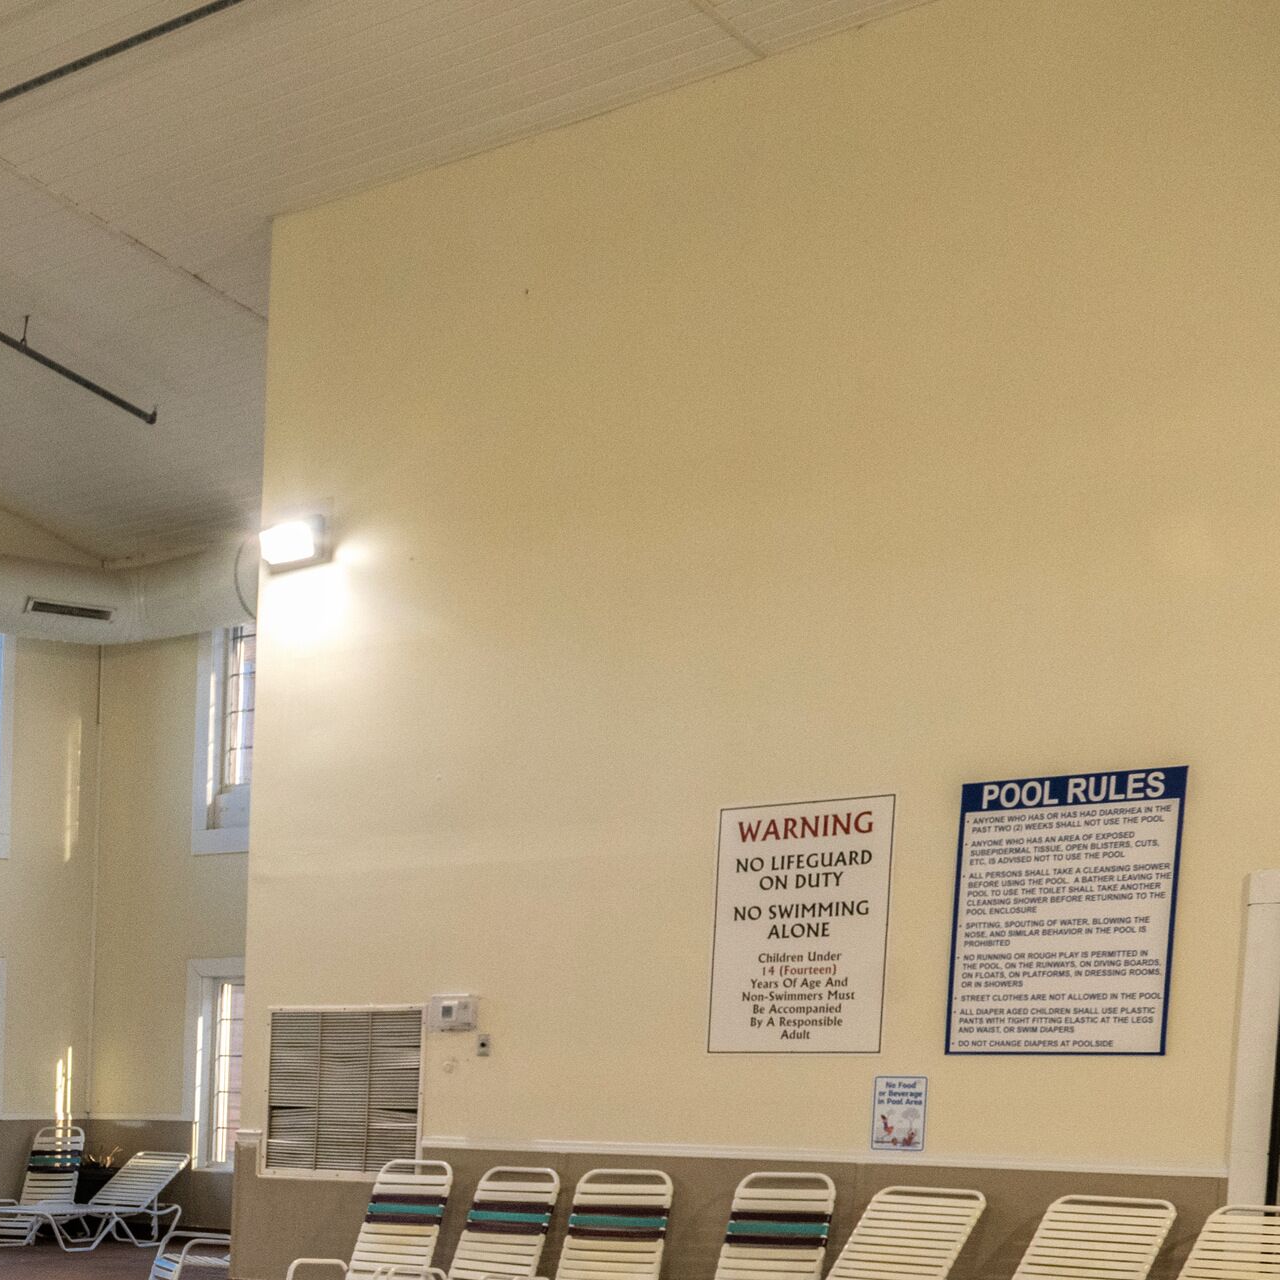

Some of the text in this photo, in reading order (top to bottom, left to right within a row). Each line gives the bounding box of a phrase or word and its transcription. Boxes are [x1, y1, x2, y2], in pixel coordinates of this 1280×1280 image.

[981, 771, 1166, 809] POOL RULES
[973, 816, 1005, 825] ANYONE
[1007, 814, 1027, 823] WHO
[1028, 813, 1045, 821] HAS
[1046, 812, 1059, 820] OR
[1060, 811, 1078, 819] HAS
[1079, 809, 1097, 818] HAD
[1099, 806, 1142, 817] DIARRHEA
[1156, 804, 1171, 813] THE
[738, 810, 874, 843] WARNING
[972, 826, 991, 834] PAST
[1013, 824, 1023, 832] (2)
[1025, 822, 1054, 831] WEEKS
[1055, 820, 1081, 829] SHALL
[1084, 818, 1101, 827] NOT
[1103, 817, 1120, 826] USE
[1123, 816, 1138, 824] THE
[1141, 814, 1164, 823] POOL
[971, 839, 1003, 848] ANYONE
[1005, 838, 1025, 846] WHO
[1026, 836, 1043, 845] HAS
[1058, 834, 1080, 843] AREA
[1082, 833, 1093, 841] OF
[1095, 831, 1135, 841] EXPOSED
[970, 847, 1030, 857] SUBEPIDERMAL
[1065, 843, 1088, 852] OPEN
[988, 857, 996, 865] IS
[998, 855, 1032, 864] ADVISED
[1034, 854, 1050, 862] NOT
[1053, 854, 1064, 862] TO
[1065, 852, 1081, 861] USE
[1084, 852, 1100, 860] THE
[1102, 850, 1125, 859] POOL
[736, 849, 872, 873] NO LIFEGUARD
[985, 870, 1023, 879] PERSONS
[1025, 869, 1050, 877] SHALL
[1053, 867, 1073, 875] TAKE
[1083, 864, 1131, 874] CLEANSING
[1133, 862, 1171, 872] SHOWER
[759, 871, 842, 891] ON DUTY
[968, 880, 999, 889] BEFORE
[1001, 879, 1026, 887] USING
[1028, 878, 1043, 886] THE
[1081, 875, 1115, 884] BATHER
[1116, 873, 1153, 882] LEAVING
[1155, 872, 1171, 880] THE
[967, 890, 987, 898] POOL
[991, 889, 1001, 897] TO
[1003, 888, 1018, 897] USE
[1039, 886, 1066, 895] TOILET
[1068, 885, 1094, 893] SHALL
[1097, 884, 1118, 892] TAKE
[1120, 882, 1161, 891] ANOTHER
[966, 891, 1166, 907] CLEANSING SHOWER BEFORE RETURNING TO THE
[734, 900, 869, 921] NO SWIMMING
[966, 906, 1037, 916] POOL ENCLOSURE
[768, 922, 829, 939] ALONE
[964, 939, 1011, 948] PROHIBITED
[758, 950, 840, 964] Children Under
[762, 964, 837, 977] 14 (Fourteen)
[751, 977, 848, 989] Years Of Age And
[742, 990, 855, 1002] Non-Swimmers Must
[961, 994, 990, 1002] STREET
[992, 994, 1029, 1002] CLOTHES
[1049, 993, 1065, 1001] NOT
[1067, 993, 1108, 1001] ALLOWED
[1121, 992, 1136, 1000] THE
[1139, 992, 1161, 1000] POOL
[753, 1003, 842, 1016] Be Accompanied
[750, 1016, 843, 1028] By A Responsible
[781, 1030, 810, 1040] Adult
[1072, 1040, 1113, 1048] POOLSIDE
[888, 1090, 922, 1098] Beverage
